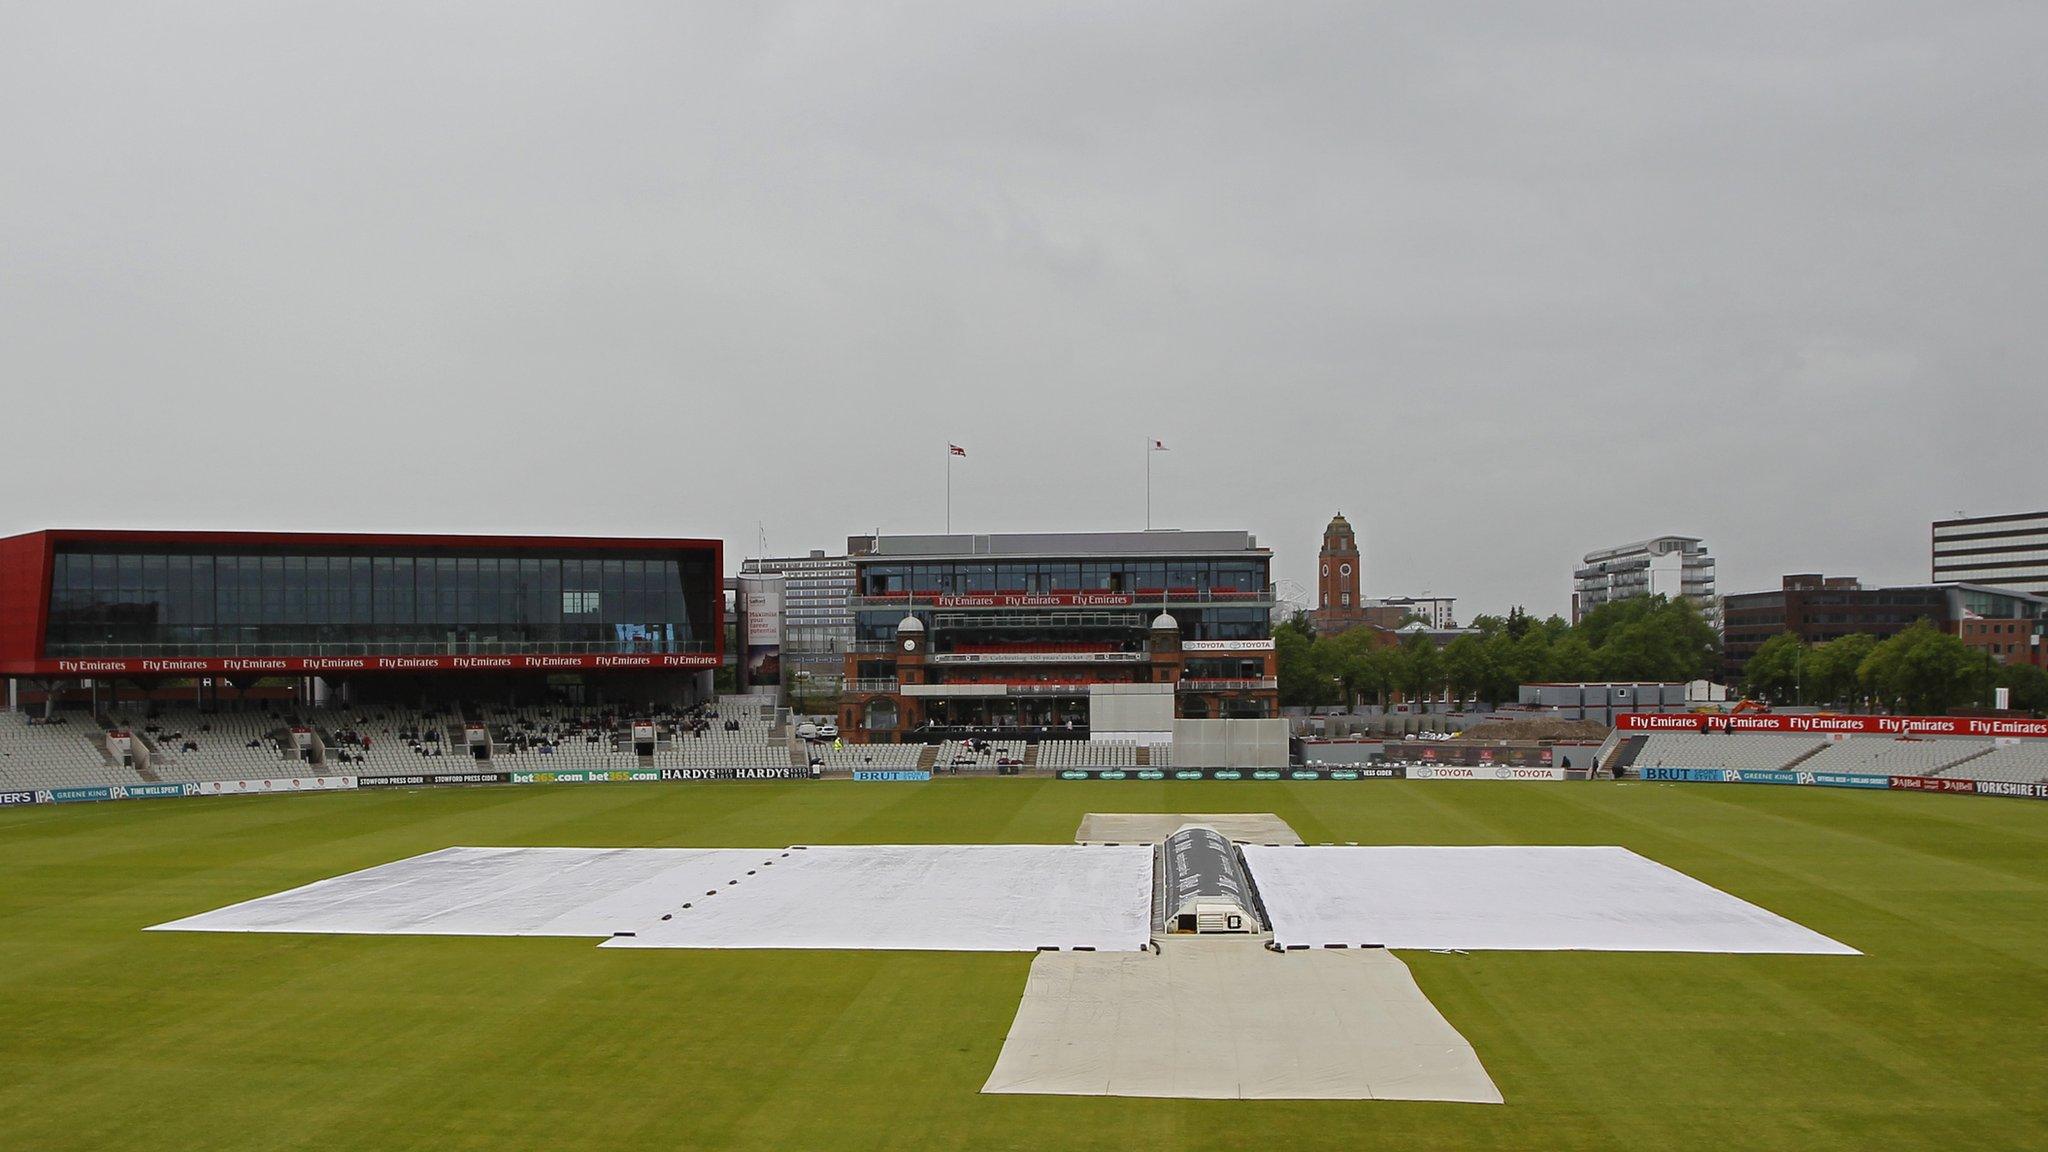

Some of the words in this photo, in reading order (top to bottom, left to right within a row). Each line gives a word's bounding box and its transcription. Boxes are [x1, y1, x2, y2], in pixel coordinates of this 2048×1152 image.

[939, 596, 954, 606] Fly
[955, 596, 993, 605] Emirates
[1005, 596, 1020, 606] Fly
[1022, 596, 1060, 605] Emirates
[1072, 595, 1087, 605] Fly
[1089, 595, 1127, 604] Emirates
[60, 660, 78, 672] Fly
[80, 660, 126, 670] Emirates
[143, 660, 161, 671] Fly
[163, 660, 207, 670] Emirates
[224, 659, 242, 670] Fly
[243, 659, 287, 669] Emirates
[303, 659, 320, 669] Fly
[322, 658, 364, 668] Emirates
[379, 658, 396, 669] Fly
[398, 658, 439, 667] Emirates
[454, 657, 470, 668] Fly
[471, 657, 511, 667] Emirates
[526, 657, 541, 667] Fly
[542, 656, 582, 666] Emirates
[596, 656, 611, 666] Fly
[613, 656, 650, 665] Emirates
[664, 656, 679, 666] Fly
[680, 656, 716, 665] Emirates
[1630, 717, 1649, 728] Fly
[1650, 717, 1698, 727] Emirates
[1708, 717, 1727, 729] Fly
[1730, 717, 1779, 728] Emirates
[1790, 718, 1810, 730] Fly
[1812, 718, 1864, 729] Emirates
[1879, 720, 1899, 732] Fly
[1902, 720, 1954, 731] Emirates
[1970, 721, 1990, 734] Fly
[1993, 721, 2047, 733] Emirates
[514, 773, 583, 783] bet365.com
[588, 771, 657, 781] bet365.com
[1434, 769, 1473, 777] TOYOTA
[1512, 769, 1552, 778] TOYOTA
[1646, 768, 1690, 780] BRUT
[1723, 770, 1742, 782] IPA
[1796, 772, 1816, 784] IPA
[56, 790, 86, 799] GREENE
[88, 789, 107, 798] KING
[110, 786, 129, 799] IPA
[161, 786, 178, 794] SPENT
[182, 783, 200, 796] IPA
[1976, 782, 2033, 796] YORKSHIRE
[34, 790, 54, 803] IPA
